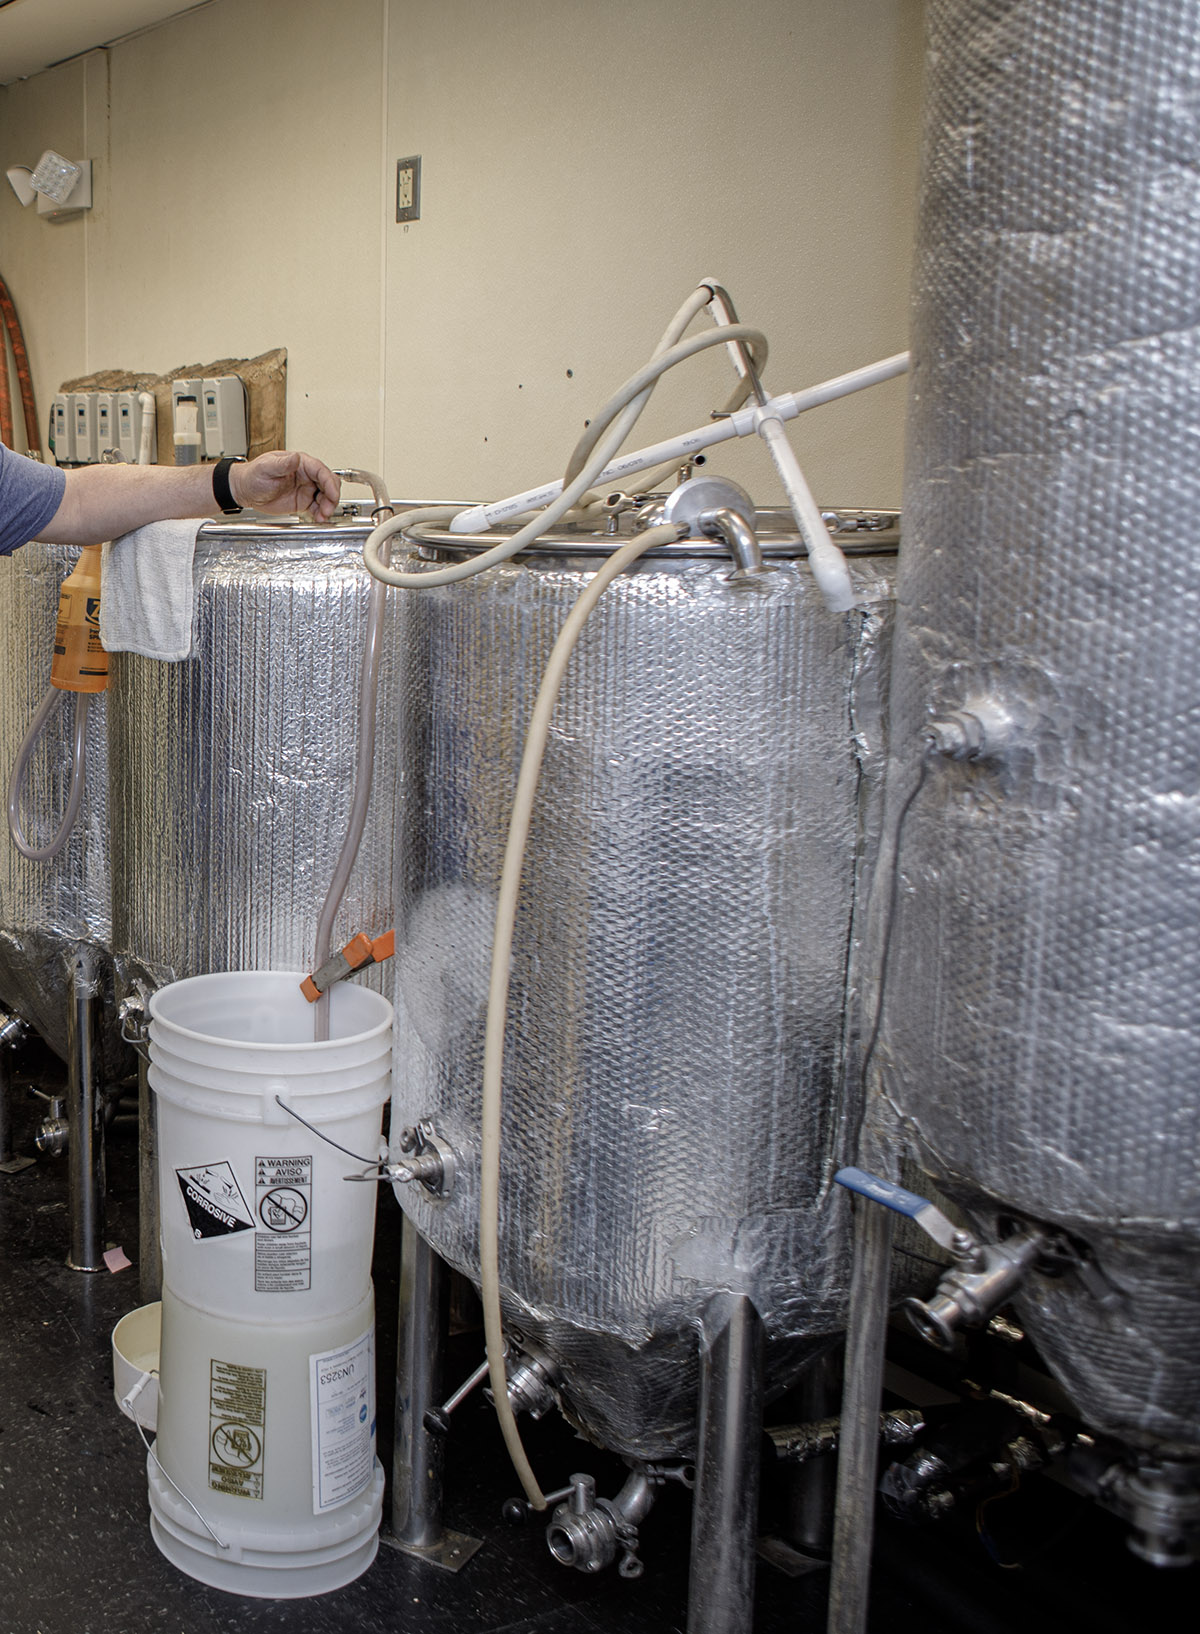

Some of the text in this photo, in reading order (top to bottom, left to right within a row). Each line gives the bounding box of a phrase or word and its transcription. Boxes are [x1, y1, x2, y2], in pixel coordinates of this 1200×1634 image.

[267, 1158, 310, 1168] WARNING
[275, 1167, 303, 1177] AVISO
[186, 1186, 237, 1229] CORROSIVE
[320, 1363, 355, 1385] UN3253
